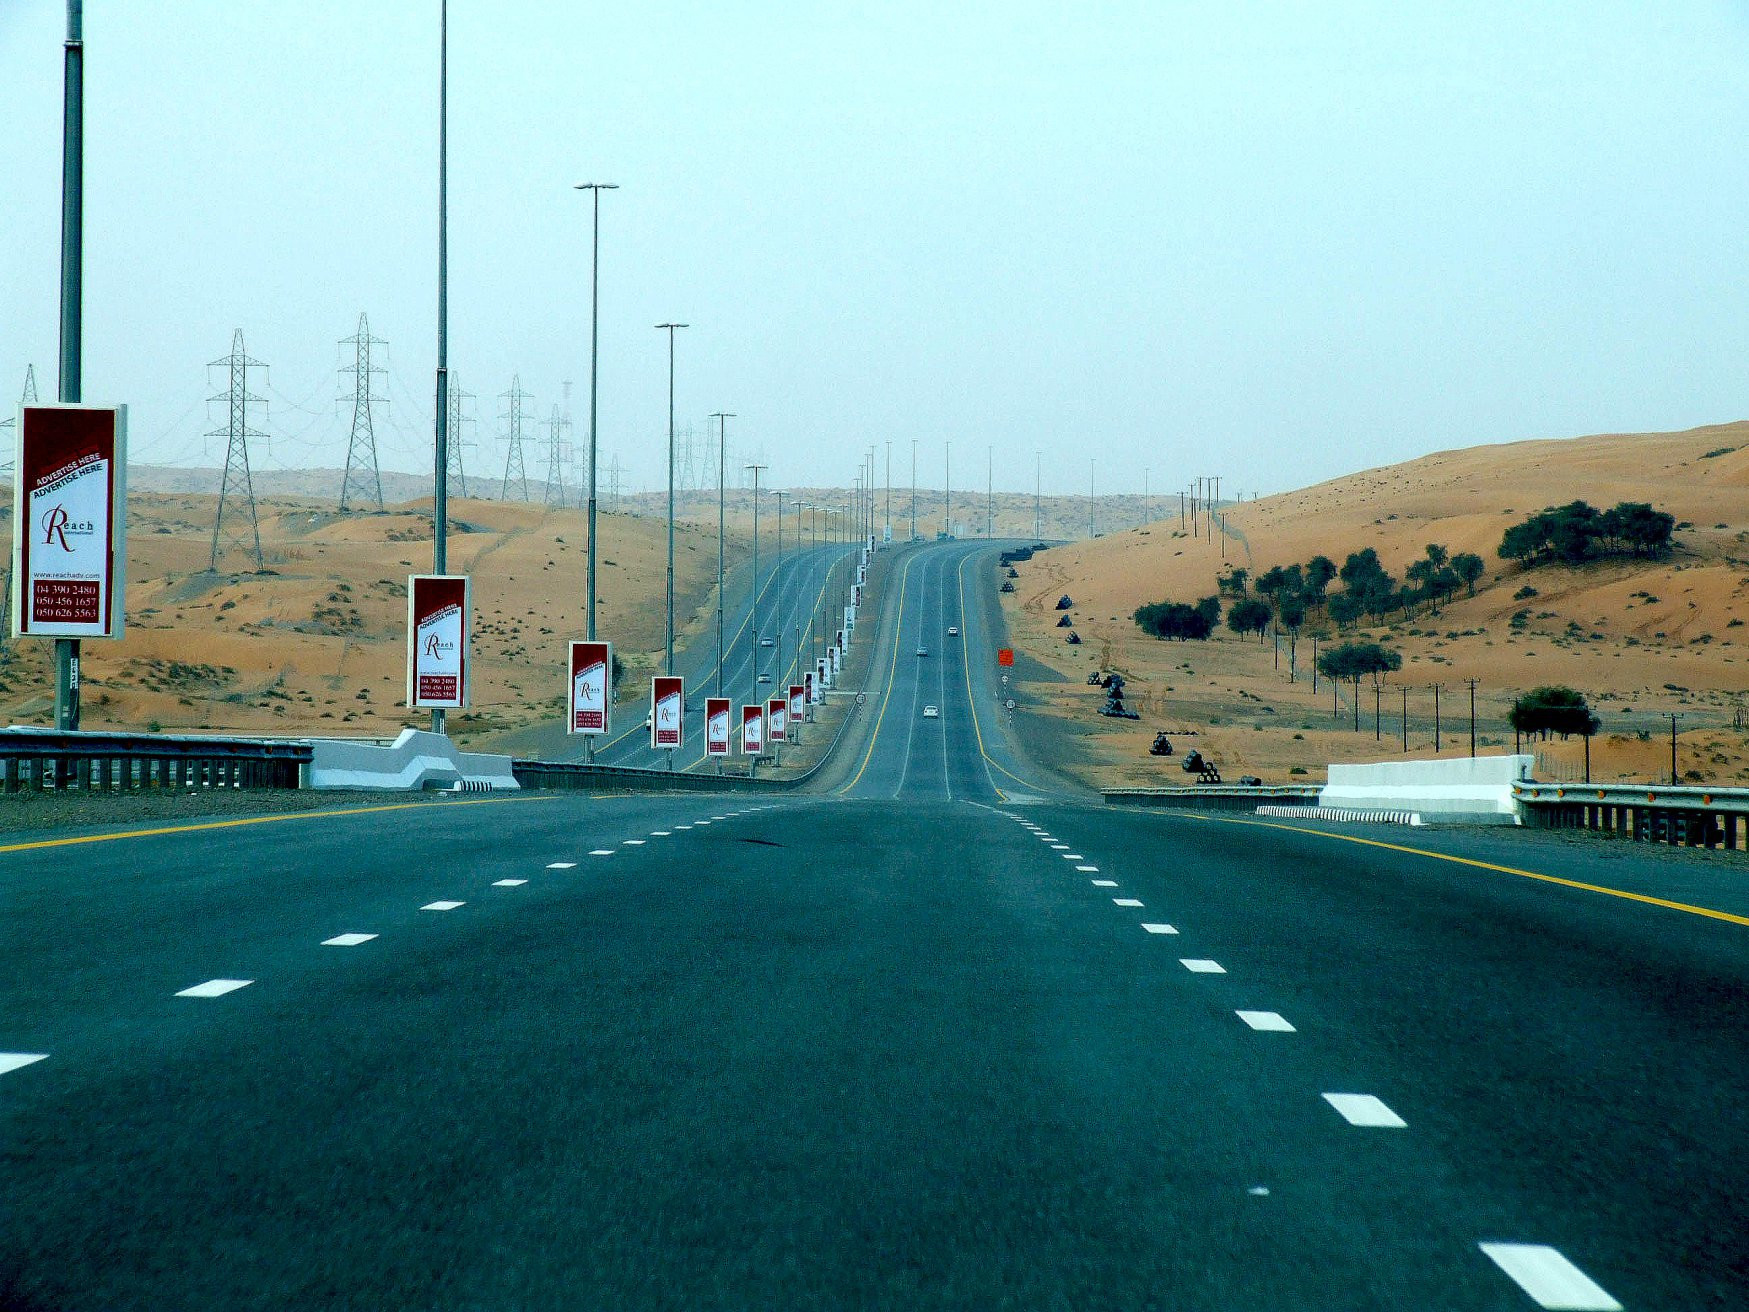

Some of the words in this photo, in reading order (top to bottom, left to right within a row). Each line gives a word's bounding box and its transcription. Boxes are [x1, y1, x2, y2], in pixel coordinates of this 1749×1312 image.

[36, 460, 79, 486] ADVERTISE
[78, 452, 101, 466] HERE
[33, 473, 79, 499] ADVERTISE
[79, 463, 103, 476] HERE
[41, 503, 93, 552] Reach
[33, 571, 100, 580] www.reachadv.com
[36, 585, 49, 594] 04
[52, 585, 70, 594] 390
[72, 585, 96, 595] 2480
[36, 596, 54, 605] 050
[55, 597, 73, 606] 456
[75, 597, 97, 606] 1657
[36, 608, 54, 617] 050
[55, 608, 72, 617] 626
[74, 608, 96, 618] 5563
